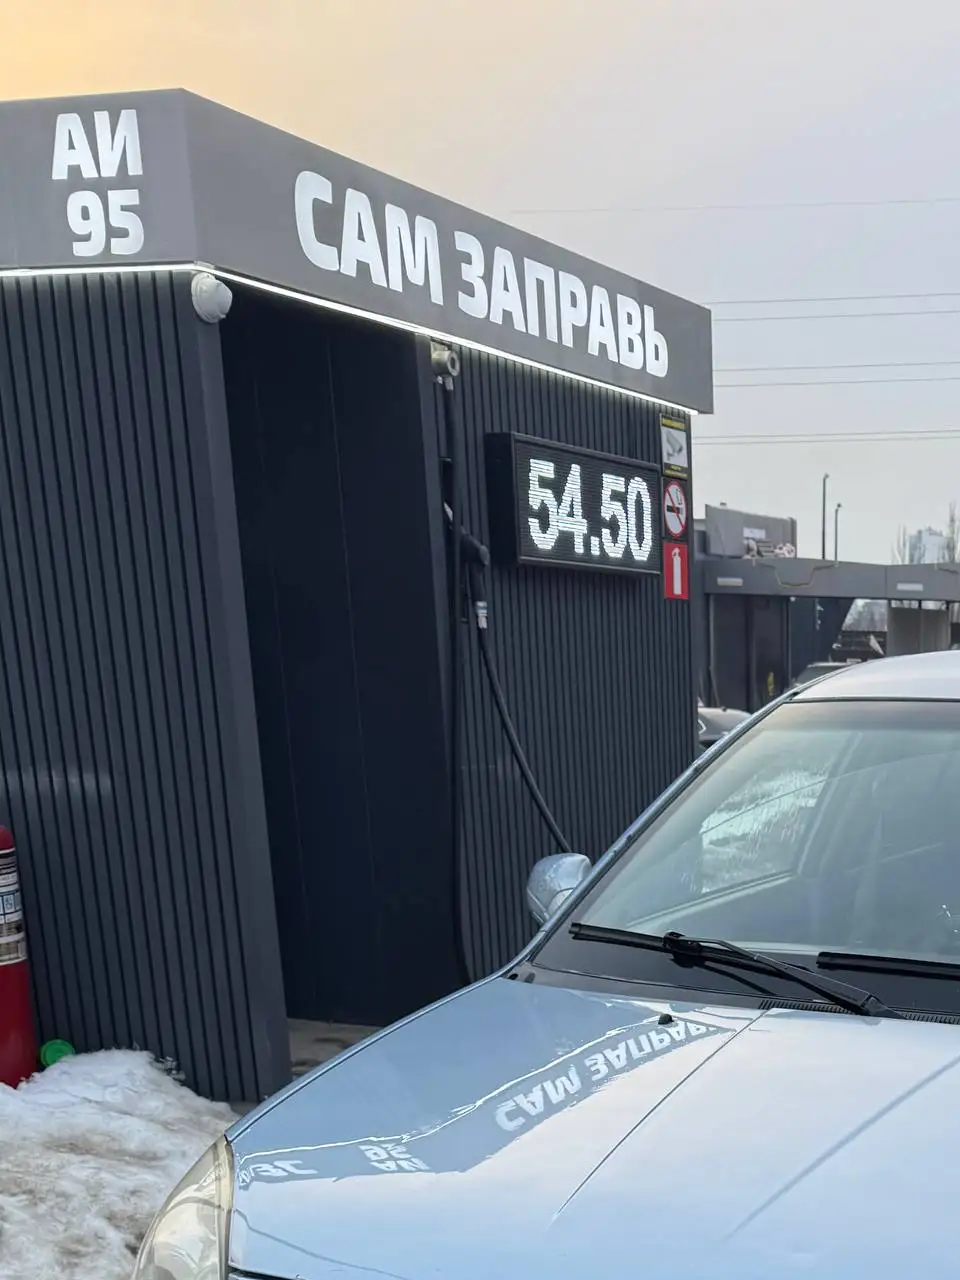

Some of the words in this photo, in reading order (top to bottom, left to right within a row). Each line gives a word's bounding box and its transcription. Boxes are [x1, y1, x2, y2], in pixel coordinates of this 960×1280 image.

[51, 108, 144, 181] АИ
[66, 189, 145, 257] 95
[294, 170, 444, 305] САМ
[454, 230, 669, 378] ЗАПРАВЬ
[526, 457, 653, 562] 54.50
